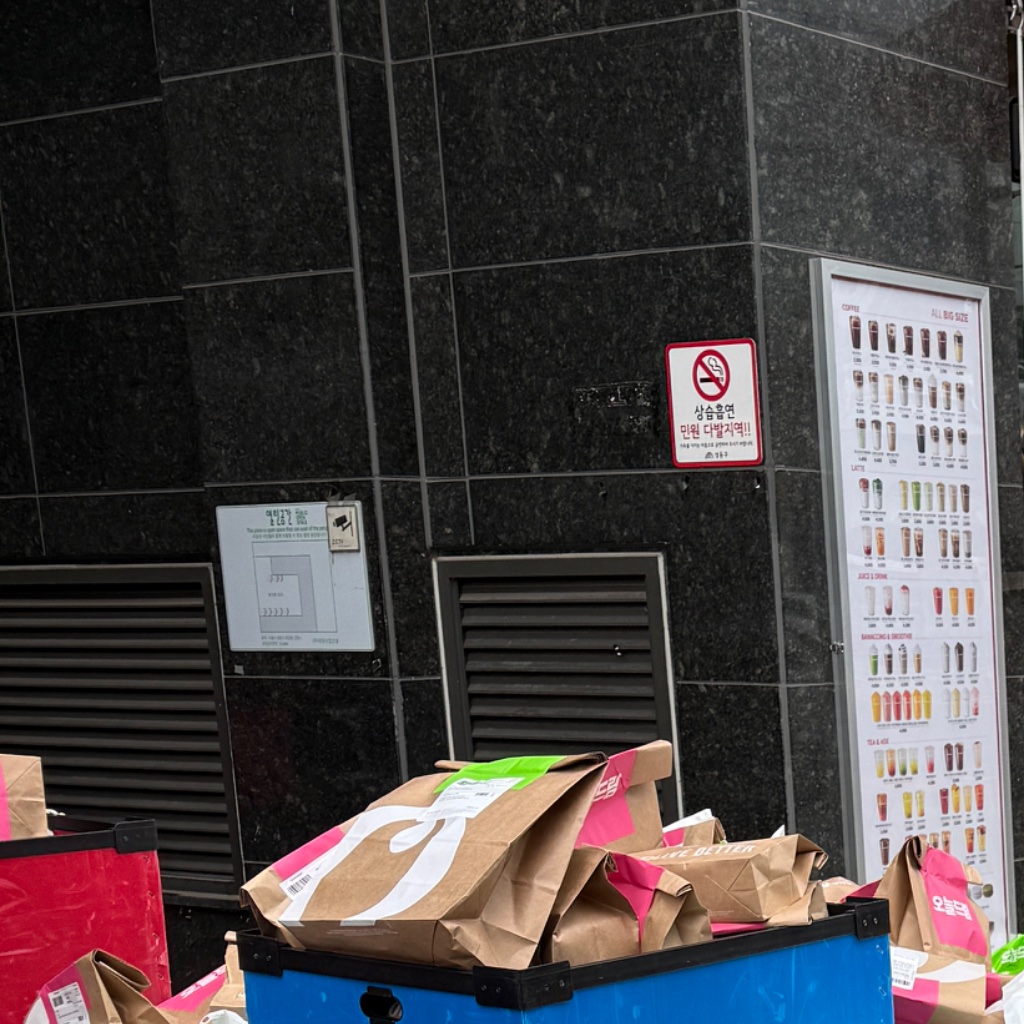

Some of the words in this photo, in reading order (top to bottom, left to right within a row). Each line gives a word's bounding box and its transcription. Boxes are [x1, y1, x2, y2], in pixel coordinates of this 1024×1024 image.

[932, 309, 942, 319] ALL
[943, 311, 954, 320] BIG
[955, 313, 968, 322] SIZE
[695, 403, 735, 421] 상습흡연
[681, 424, 700, 440] 민원
[704, 422, 751, 438] 다발지역!!
[693, 844, 756, 857] BETTER
[932, 895, 973, 921] 오늘드림
